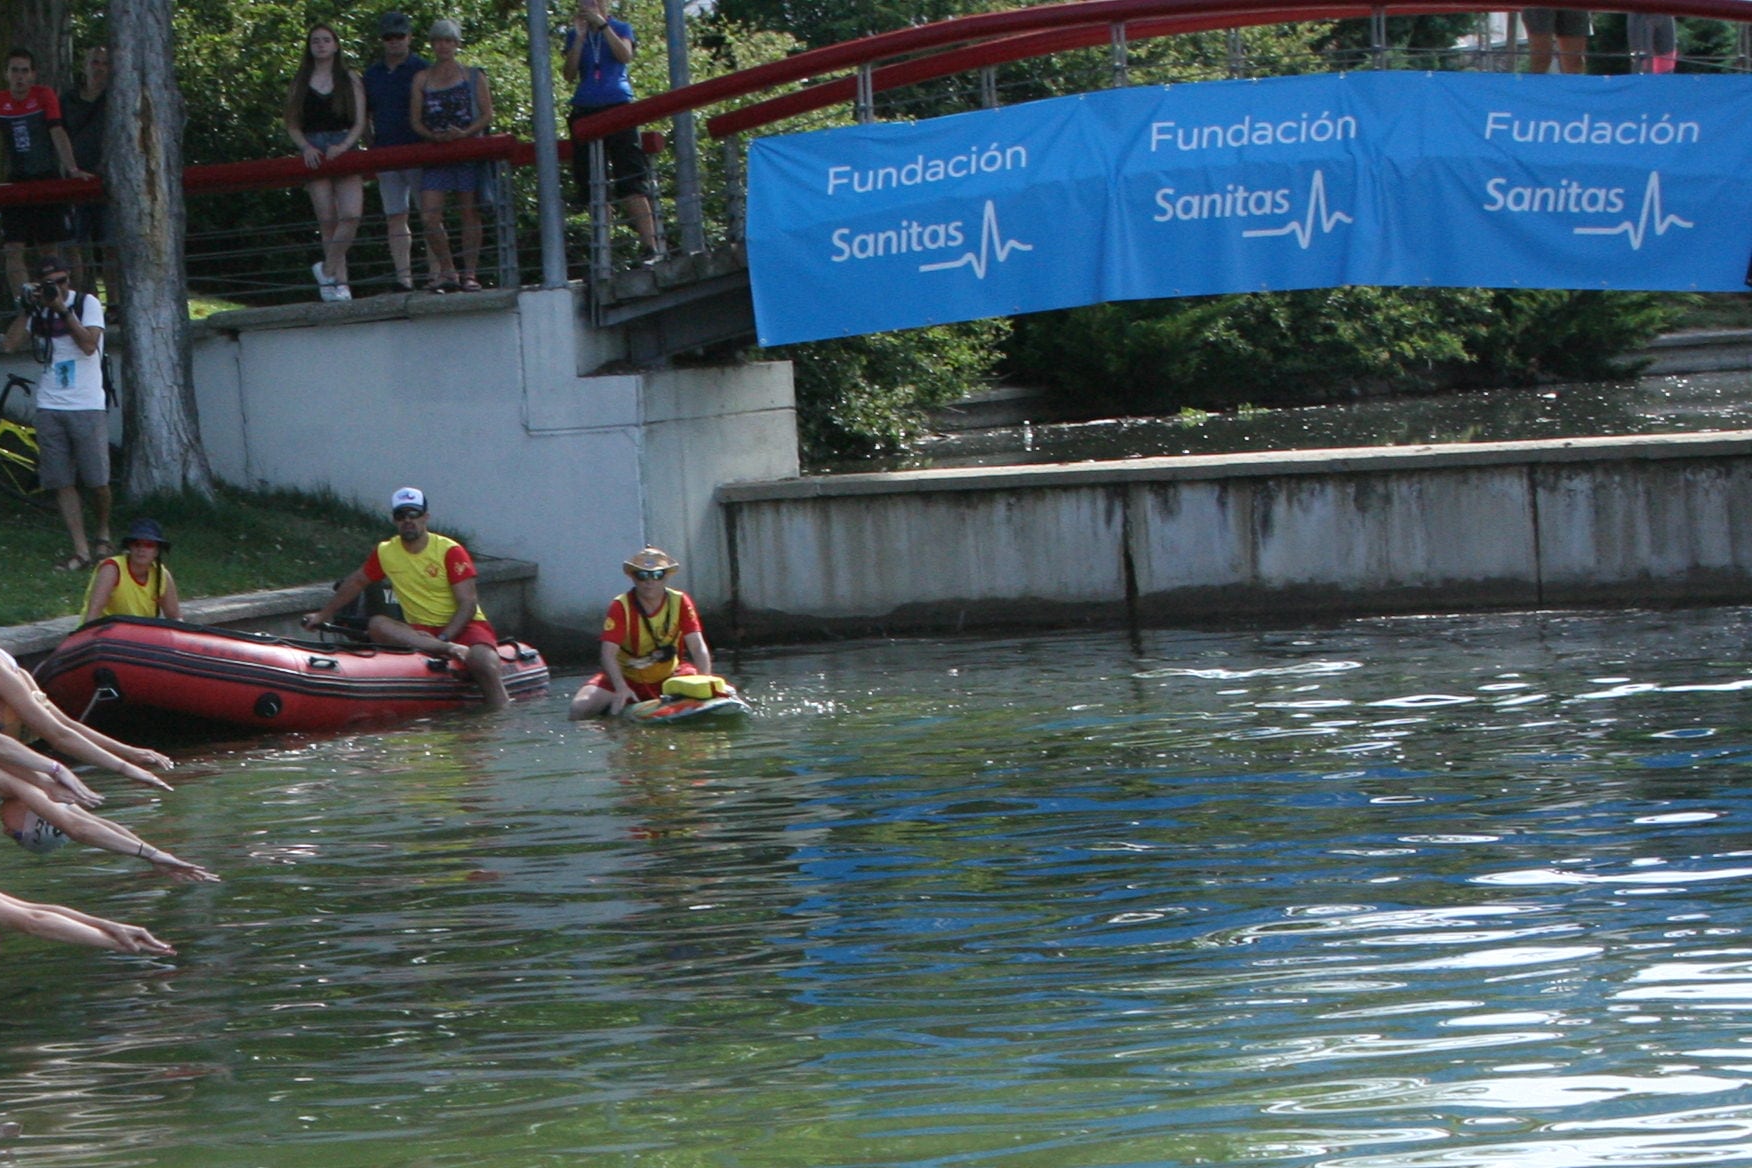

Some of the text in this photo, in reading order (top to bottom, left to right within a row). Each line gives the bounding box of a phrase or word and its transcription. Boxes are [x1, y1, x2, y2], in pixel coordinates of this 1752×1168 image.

[1150, 111, 1357, 152] Fundación
[1484, 112, 1700, 145] Fundación
[827, 141, 1028, 196] Fundación
[1153, 184, 1290, 223] Sanitas
[1483, 178, 1626, 214] Sanitas
[831, 219, 965, 263] Sanitas
